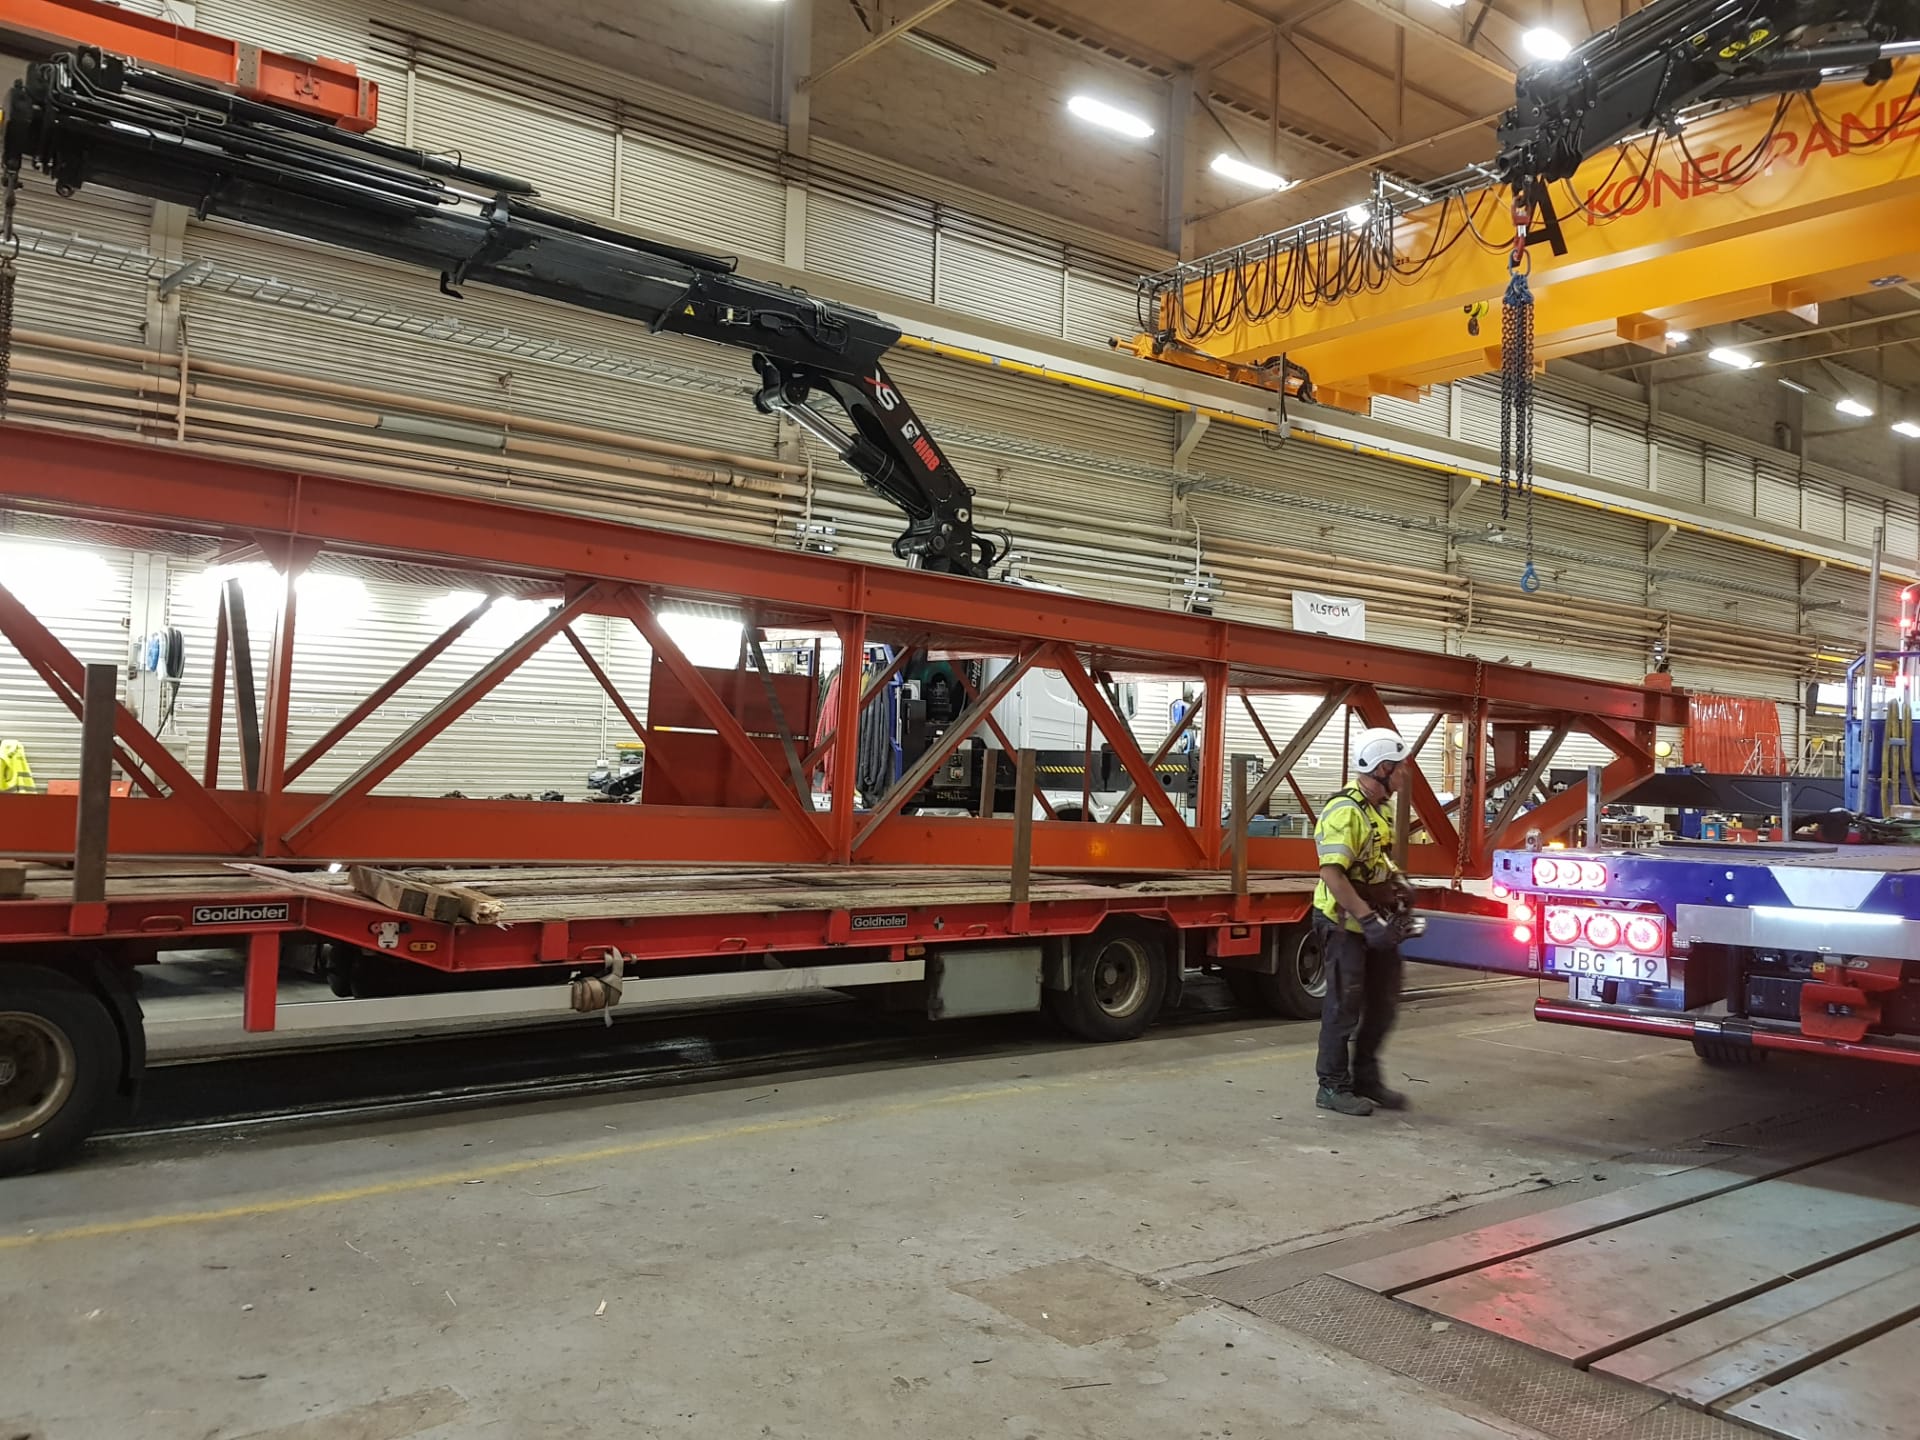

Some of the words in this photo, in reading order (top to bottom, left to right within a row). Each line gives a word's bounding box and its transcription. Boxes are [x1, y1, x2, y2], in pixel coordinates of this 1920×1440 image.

[1507, 172, 1568, 269] A
[912, 436, 940, 472] HIAB
[1310, 602, 1350, 617] ALSTOM
[196, 906, 285, 921] Goldhofer
[854, 915, 905, 928] Goldhofer
[1563, 950, 1606, 973] JBG
[1616, 956, 1658, 978] 119
